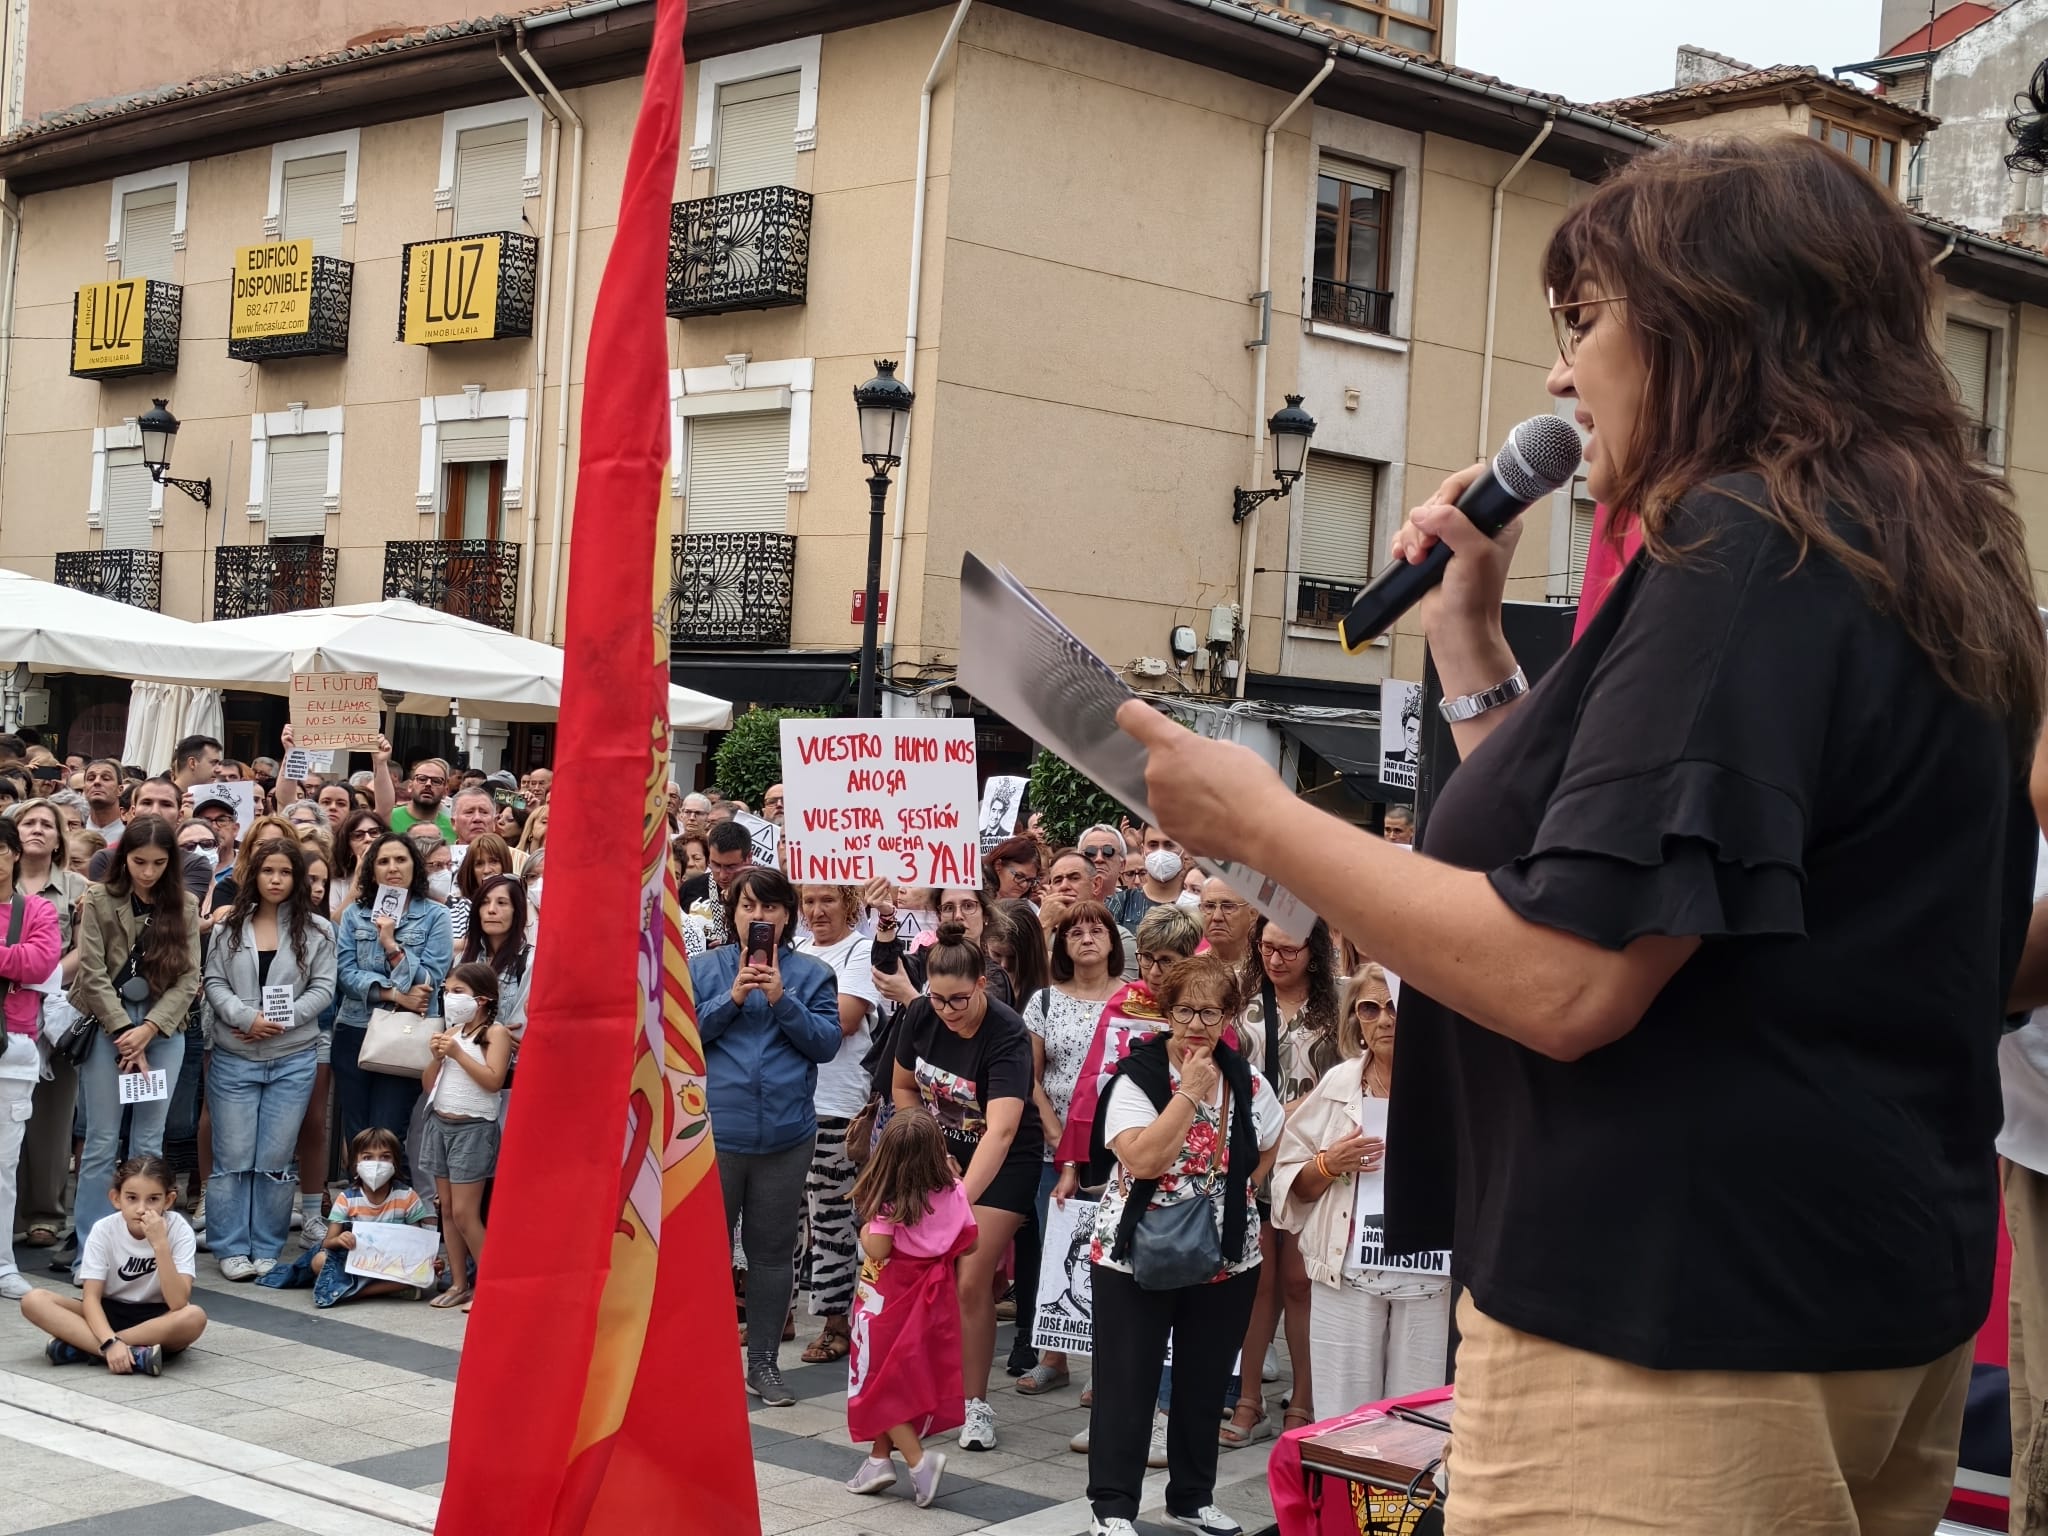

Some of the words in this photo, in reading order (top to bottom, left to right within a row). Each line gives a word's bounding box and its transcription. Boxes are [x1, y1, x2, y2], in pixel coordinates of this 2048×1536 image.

[248, 244, 298, 271] EDIFICIO
[419, 250, 429, 293] FINCAS
[426, 243, 484, 322] LUZ
[237, 271, 308, 298] DISPONIBLE
[90, 282, 134, 351] LUZ
[246, 303, 261, 317] 682
[263, 301, 279, 314] 477
[280, 299, 296, 313] 240
[236, 319, 305, 334] www.fincasluz.com
[424, 326, 479, 338] INMOBILIARIA
[294, 675, 316, 692] EL
[307, 700, 326, 712] EN
[331, 699, 372, 712] LLAMAS
[306, 716, 319, 726] NO
[322, 715, 336, 725] ES
[342, 713, 367, 725] MÁS
[797, 733, 882, 765] VUESTRO
[894, 735, 938, 763] HUMO
[945, 739, 975, 764] NOS
[847, 769, 907, 796] AHOGA
[803, 807, 884, 832] VUESTRA
[844, 834, 871, 851] NOS
[877, 836, 924, 851] QUEMA
[897, 852, 918, 883] 3
[123, 1256, 157, 1273] NIKE
